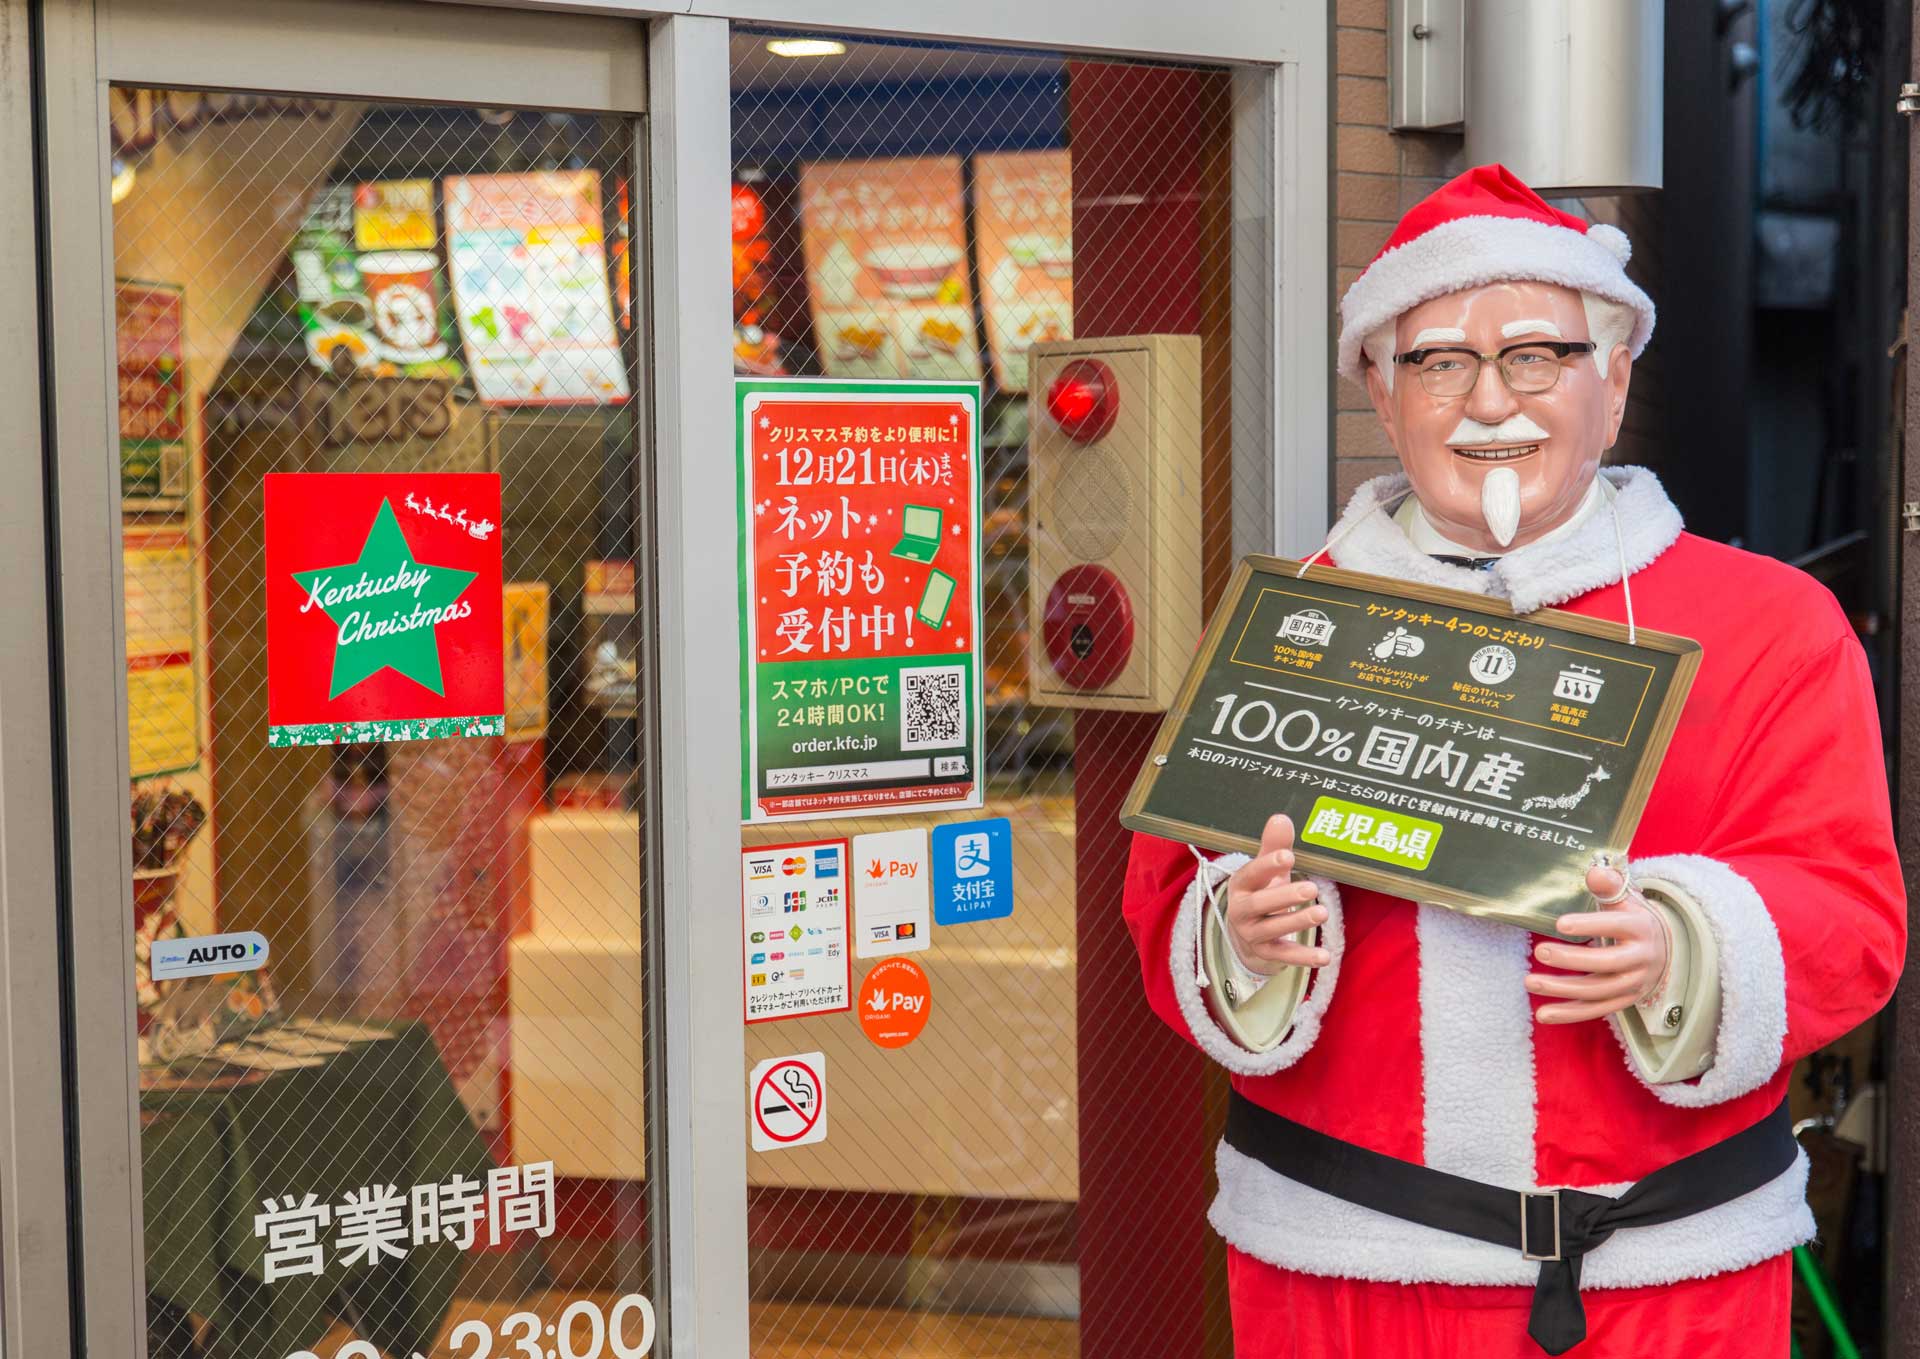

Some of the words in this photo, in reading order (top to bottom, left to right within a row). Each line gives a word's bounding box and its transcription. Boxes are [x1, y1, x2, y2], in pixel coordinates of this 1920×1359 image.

[769, 426, 959, 443] クリスマス予約をより便利に!
[773, 496, 861, 540] ネット
[775, 550, 885, 597] 予約も
[300, 560, 431, 613] Kentucky
[337, 600, 472, 646] Christmas
[776, 605, 914, 656] 受付中!
[1289, 618, 1327, 637] 国内産
[1366, 603, 1545, 650] ケンタッキー4つのこだわり
[1349, 661, 1430, 682] チキンスペシャリストが
[1481, 655, 1503, 675] 11
[771, 675, 890, 701] スマホ/PCで
[1357, 672, 1413, 689] お店で手づくり
[777, 703, 885, 728] 24時間OK!
[1335, 695, 1496, 741] ケンタッキーのチキンは
[792, 735, 878, 754] order.kfc.jp
[1211, 693, 1525, 801] 100%国内産
[940, 761, 959, 772] 検索
[1308, 807, 1433, 861] 鹿児島県
[753, 865, 772, 874] VISA
[889, 861, 918, 879] Pay
[952, 879, 995, 902] 支付宝
[956, 901, 992, 913] ALIPAY
[874, 930, 890, 939] VISA
[187, 943, 246, 964] AUTO
[827, 949, 840, 957] Edy
[892, 992, 925, 1013] Pay
[254, 1159, 555, 1284] 営業時間
